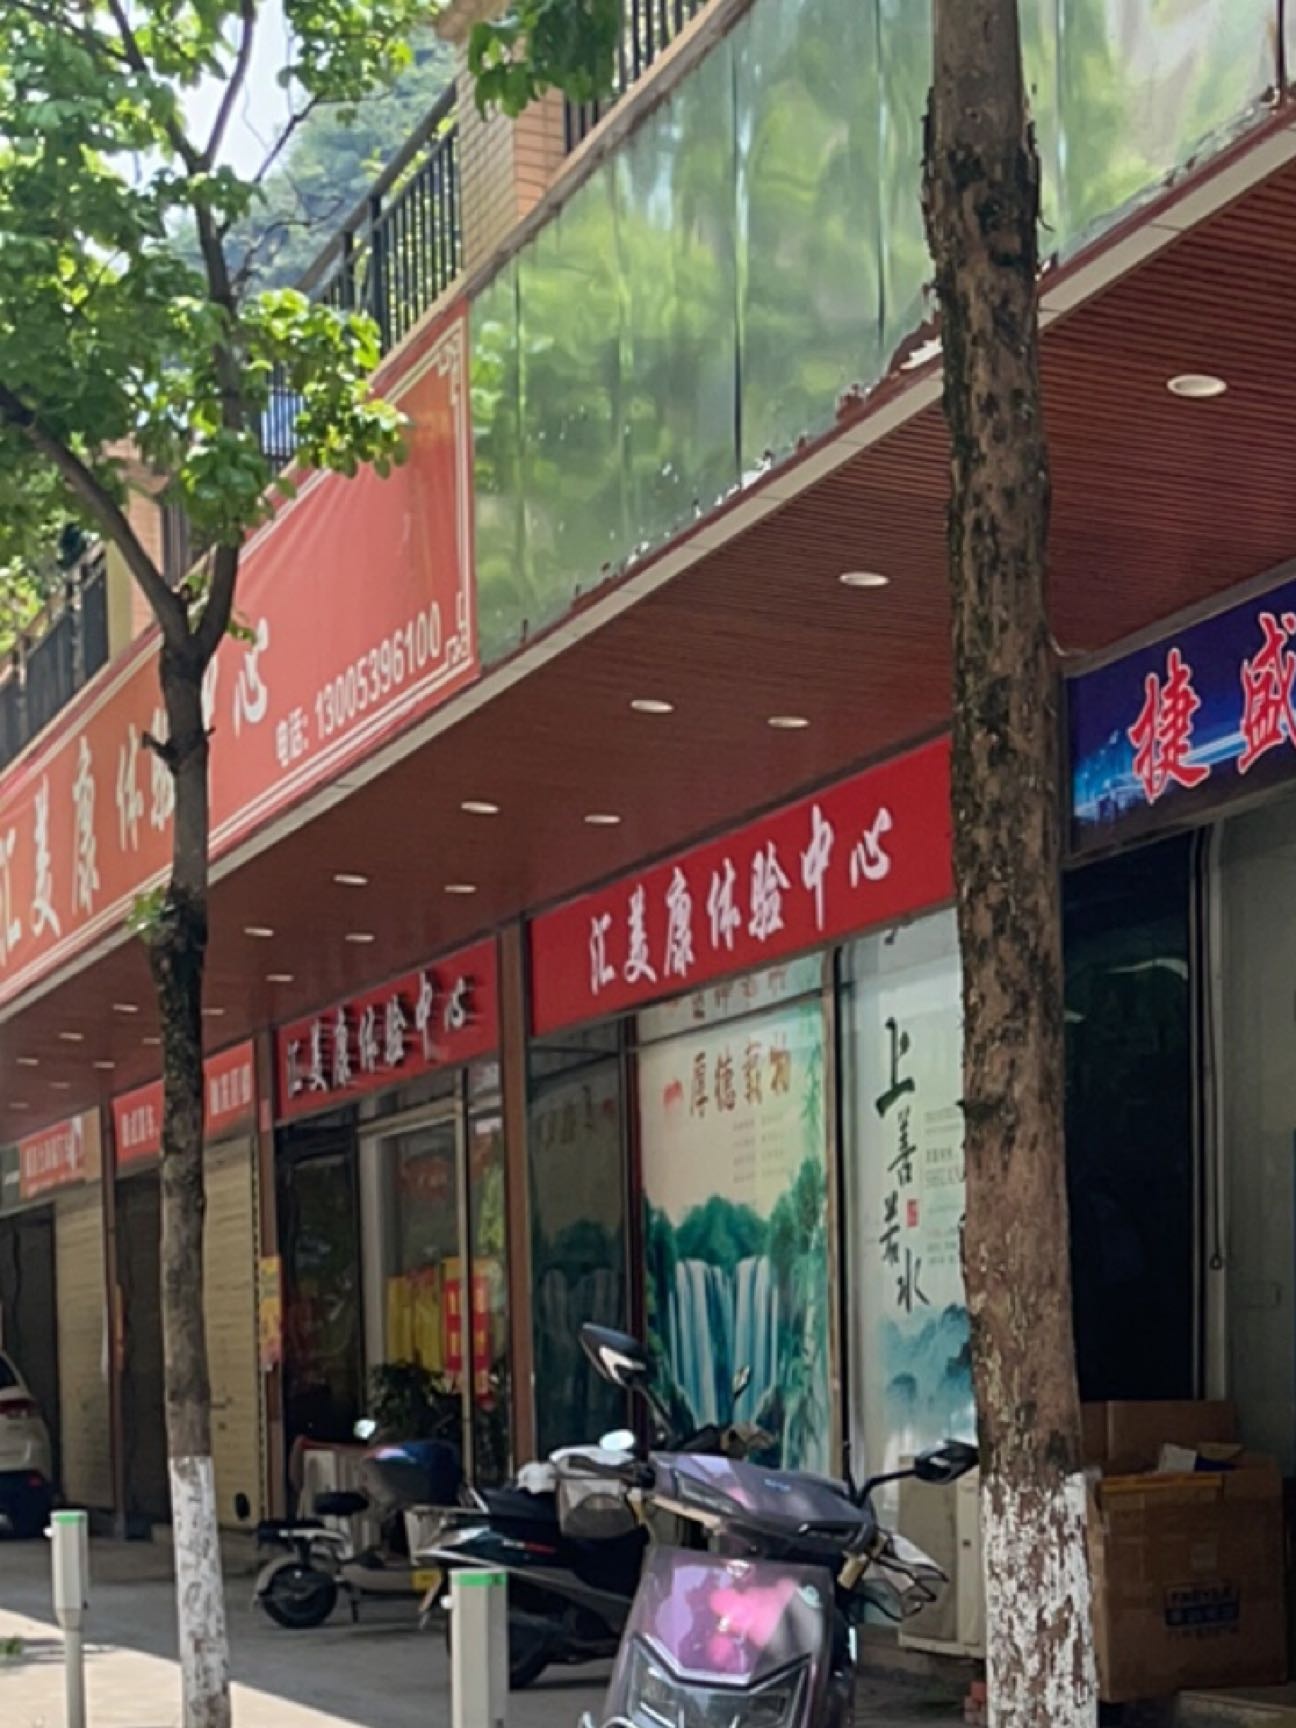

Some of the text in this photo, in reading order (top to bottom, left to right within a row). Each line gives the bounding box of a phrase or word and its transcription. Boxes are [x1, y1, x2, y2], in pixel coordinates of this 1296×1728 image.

[589, 803, 893, 996] 汇美康体验中心
